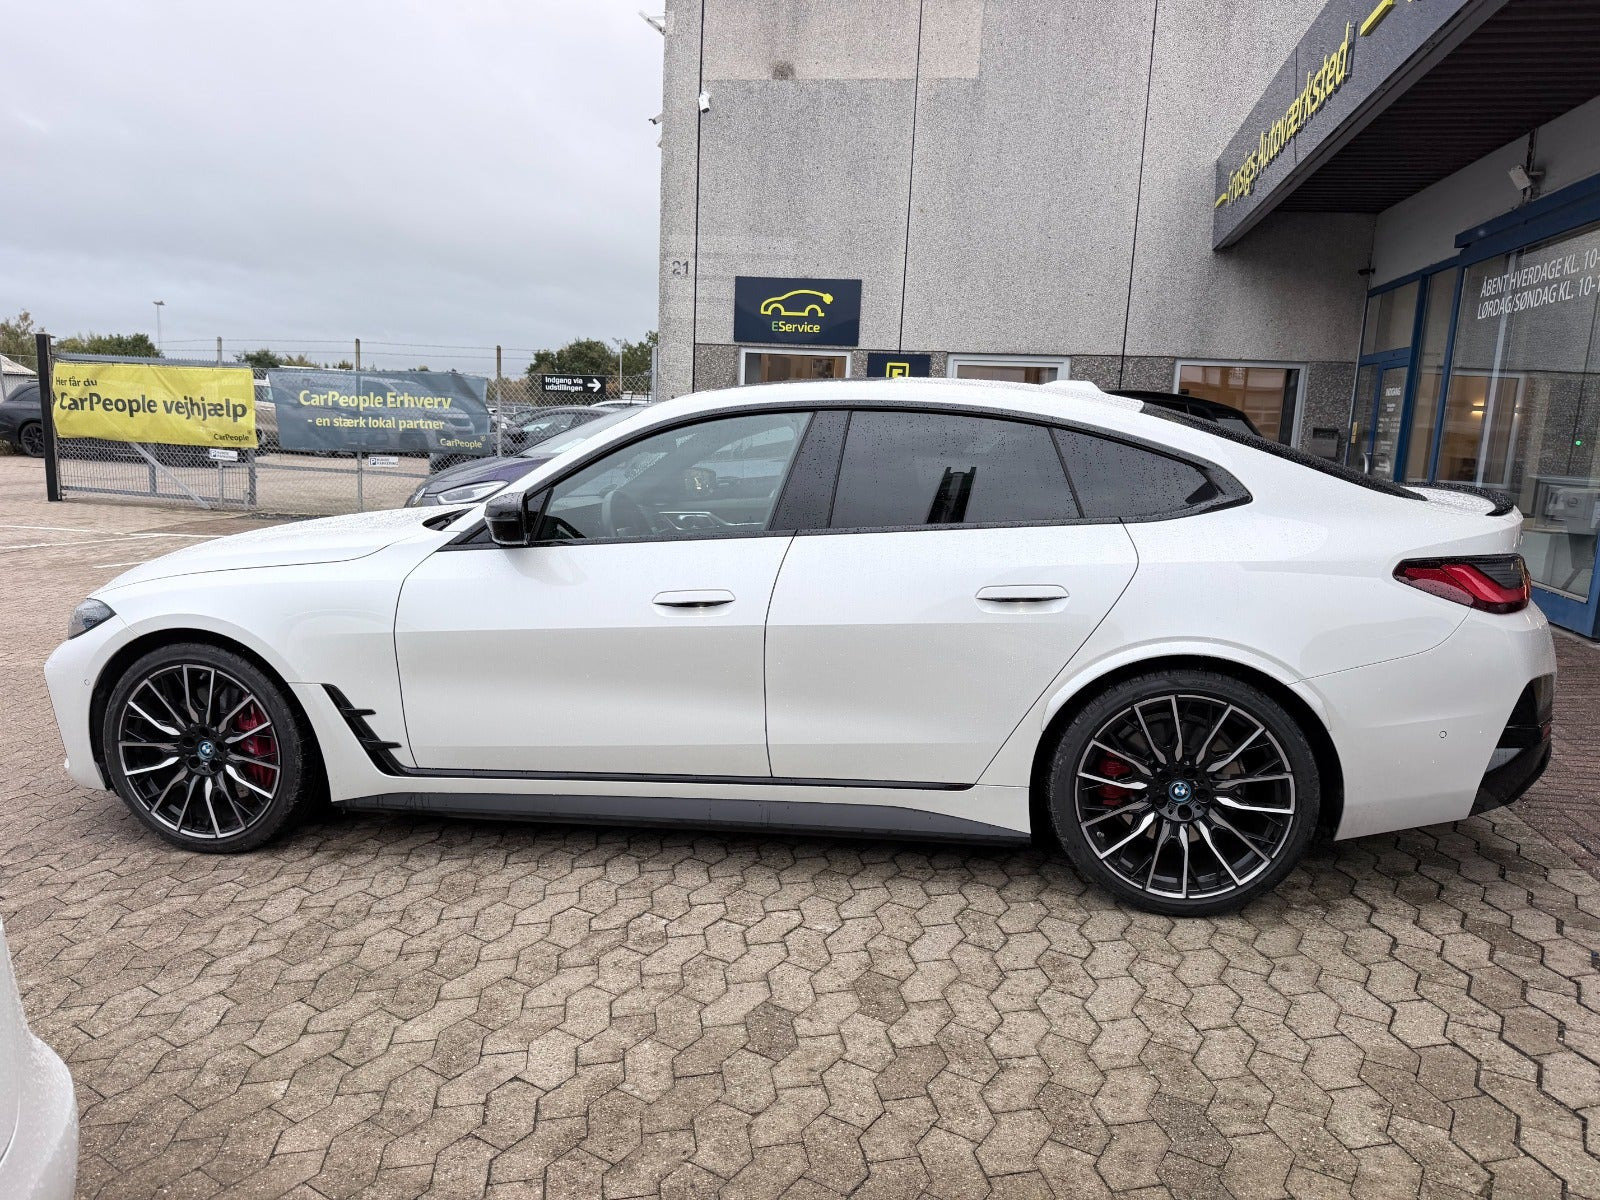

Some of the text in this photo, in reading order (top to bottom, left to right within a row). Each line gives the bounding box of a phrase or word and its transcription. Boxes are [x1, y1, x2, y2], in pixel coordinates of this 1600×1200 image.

[1257, 21, 1350, 174] Autoværksted
[672, 260, 689, 275] 21
[1480, 275, 1509, 298] ÅBENT
[1509, 258, 1563, 290] HVERDAGE
[1563, 253, 1580, 275] KL.
[1477, 284, 1557, 320] LØRDAG/SØNDAG
[1558, 280, 1574, 301] KL.
[771, 320, 821, 333] EService
[55, 376, 98, 387] Her får du
[545, 376, 583, 385] Indgang via
[545, 384, 583, 393] udstillingen
[59, 391, 248, 423] CarPeople vejhjælp
[299, 389, 453, 412] CarPeople Erhverv
[315, 417, 331, 427] en
[333, 416, 366, 428] stærk
[368, 416, 396, 429] lokal
[398, 417, 445, 432] partner
[213, 433, 250, 443] CarPeople
[440, 438, 482, 450] CarPeople
